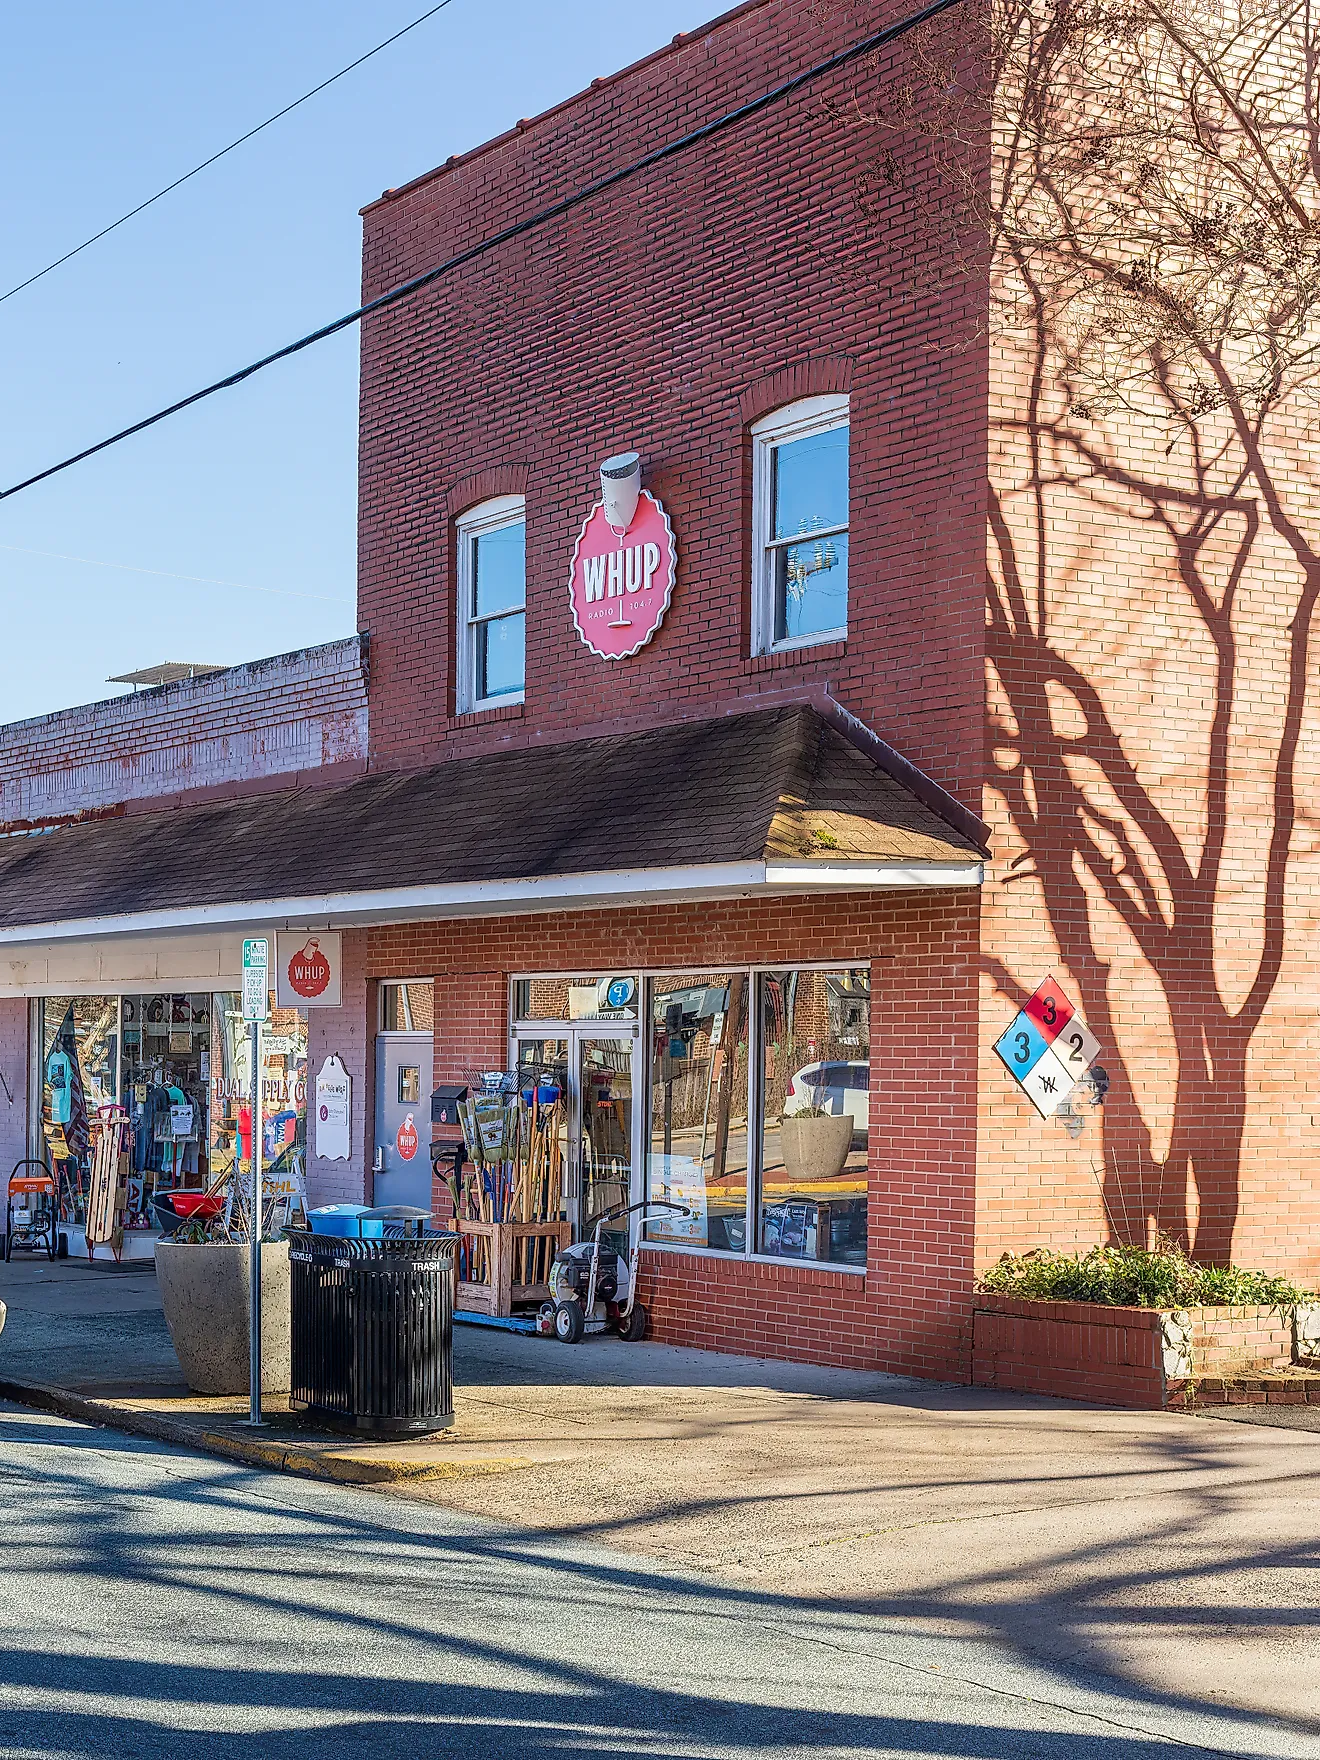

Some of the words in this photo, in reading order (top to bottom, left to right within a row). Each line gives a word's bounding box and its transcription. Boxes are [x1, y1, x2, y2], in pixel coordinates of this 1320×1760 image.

[583, 543, 660, 603] WHUP
[588, 608, 613, 619] RADIO
[629, 598, 653, 611] 104.7
[294, 965, 325, 980] WHUP
[1042, 996, 1057, 1025] 3
[1013, 1031, 1031, 1063] 3
[1068, 1033, 1084, 1062] 2
[216, 1077, 244, 1100] DUAL
[400, 1135, 416, 1147] WHUP
[334, 1258, 351, 1269] TRASH
[411, 1262, 440, 1272] TRASH
